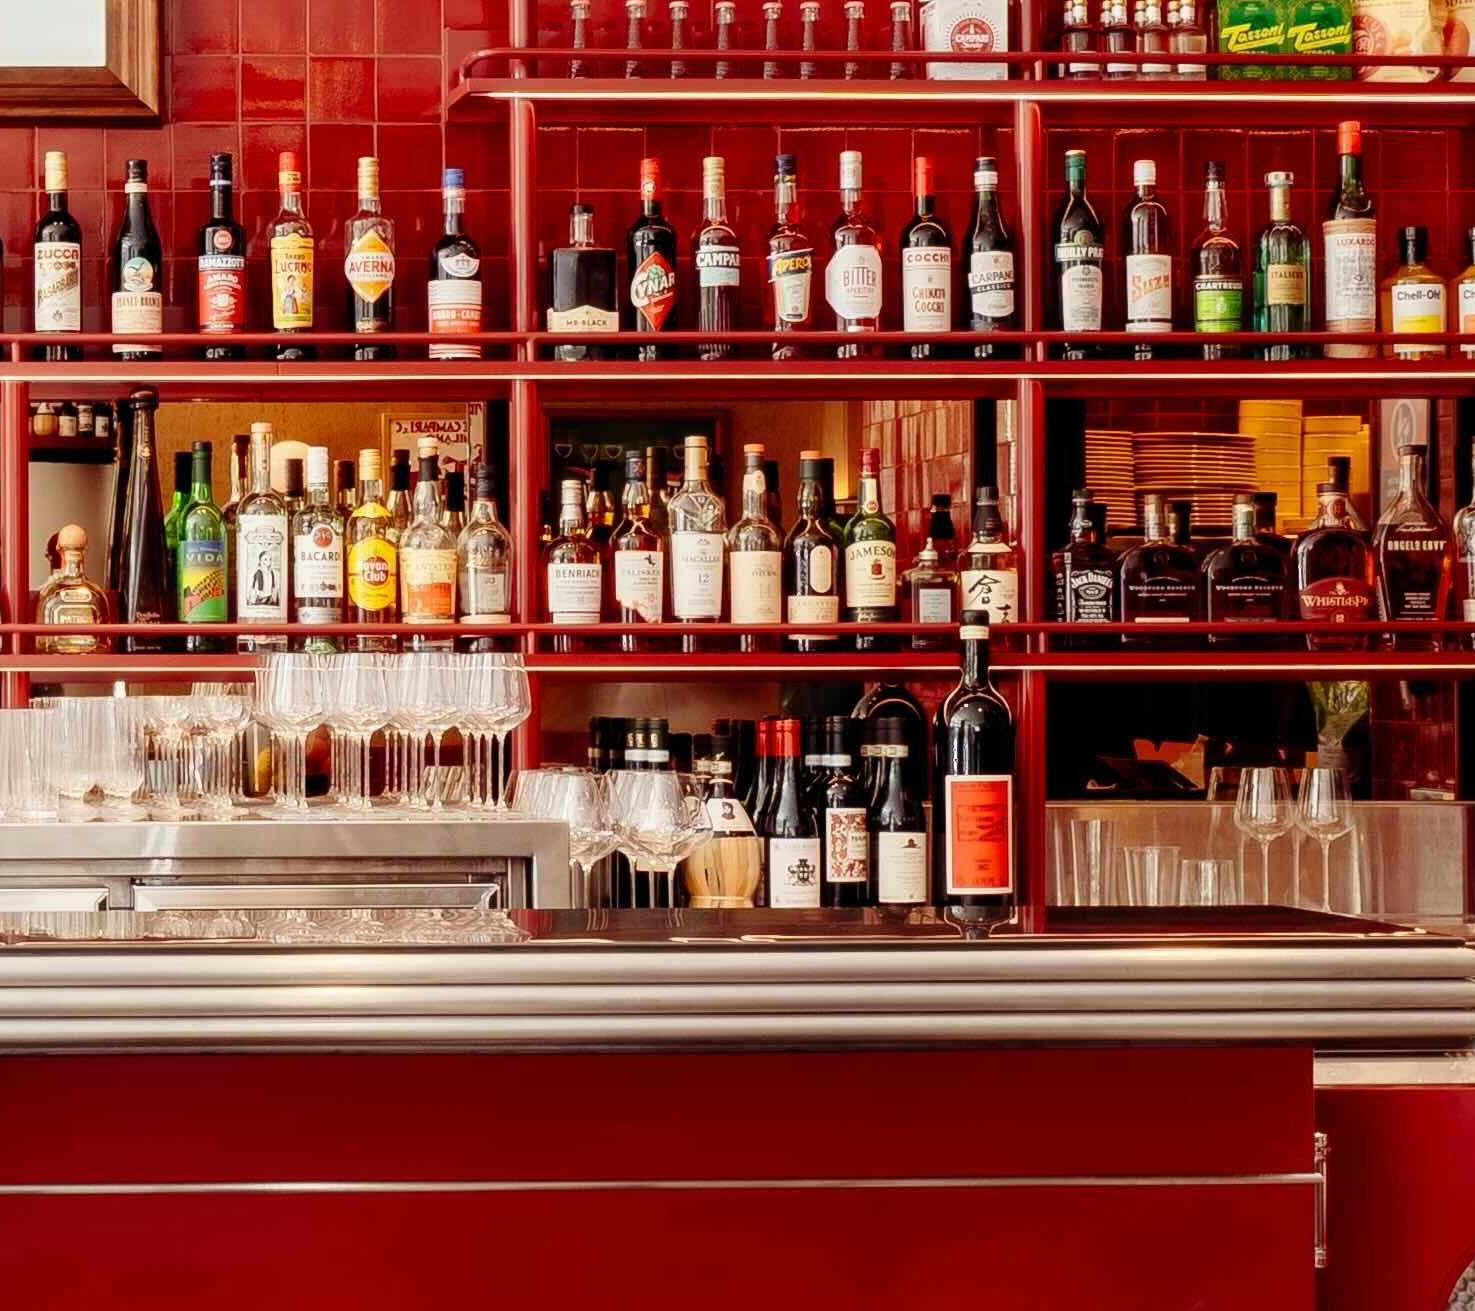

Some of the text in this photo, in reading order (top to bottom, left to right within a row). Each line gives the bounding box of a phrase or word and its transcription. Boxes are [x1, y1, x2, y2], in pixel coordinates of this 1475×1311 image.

[349, 261, 393, 273] AVERNA
[1397, 289, 1441, 302] Chell-Oh!
[185, 552, 224, 564] VIDA
[301, 551, 342, 562] BACARD
